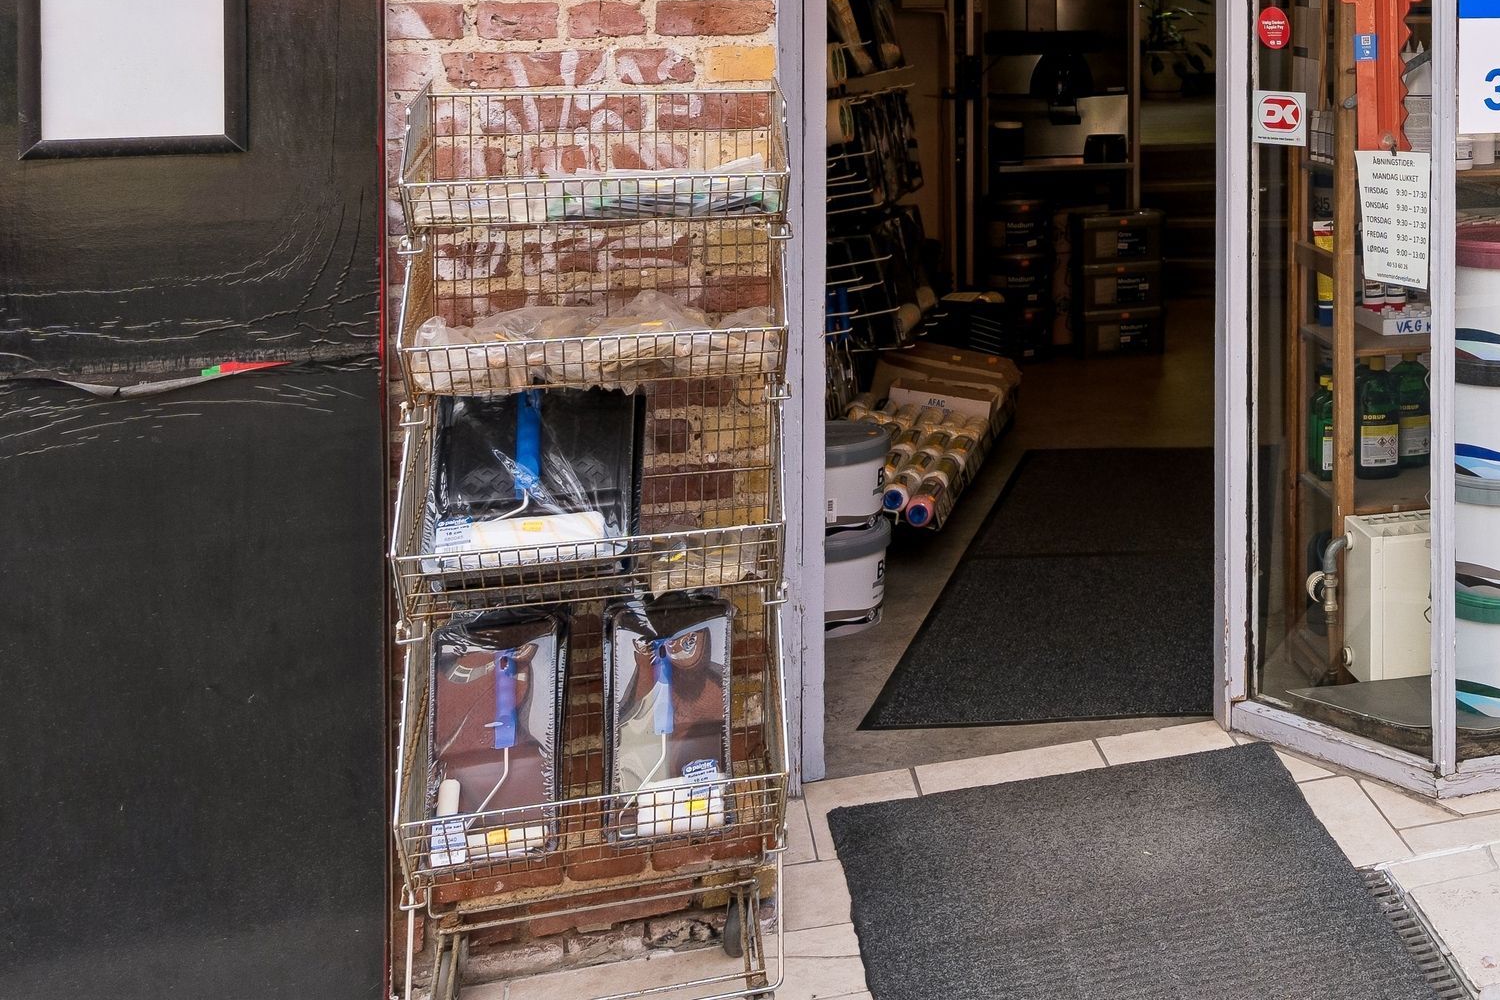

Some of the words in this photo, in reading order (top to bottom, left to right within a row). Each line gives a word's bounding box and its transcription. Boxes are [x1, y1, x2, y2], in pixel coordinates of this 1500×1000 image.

[1372, 173, 1398, 181] MANDAG
[1399, 174, 1419, 182] LUKKET
[1364, 186, 1388, 195] TIRSDAG
[1365, 201, 1389, 209] ONSDAG
[1366, 216, 1391, 225] TORSDAG
[1366, 230, 1388, 239] FREDAG
[1366, 245, 1389, 254] LØRDAG
[1396, 319, 1422, 333] VÆG
